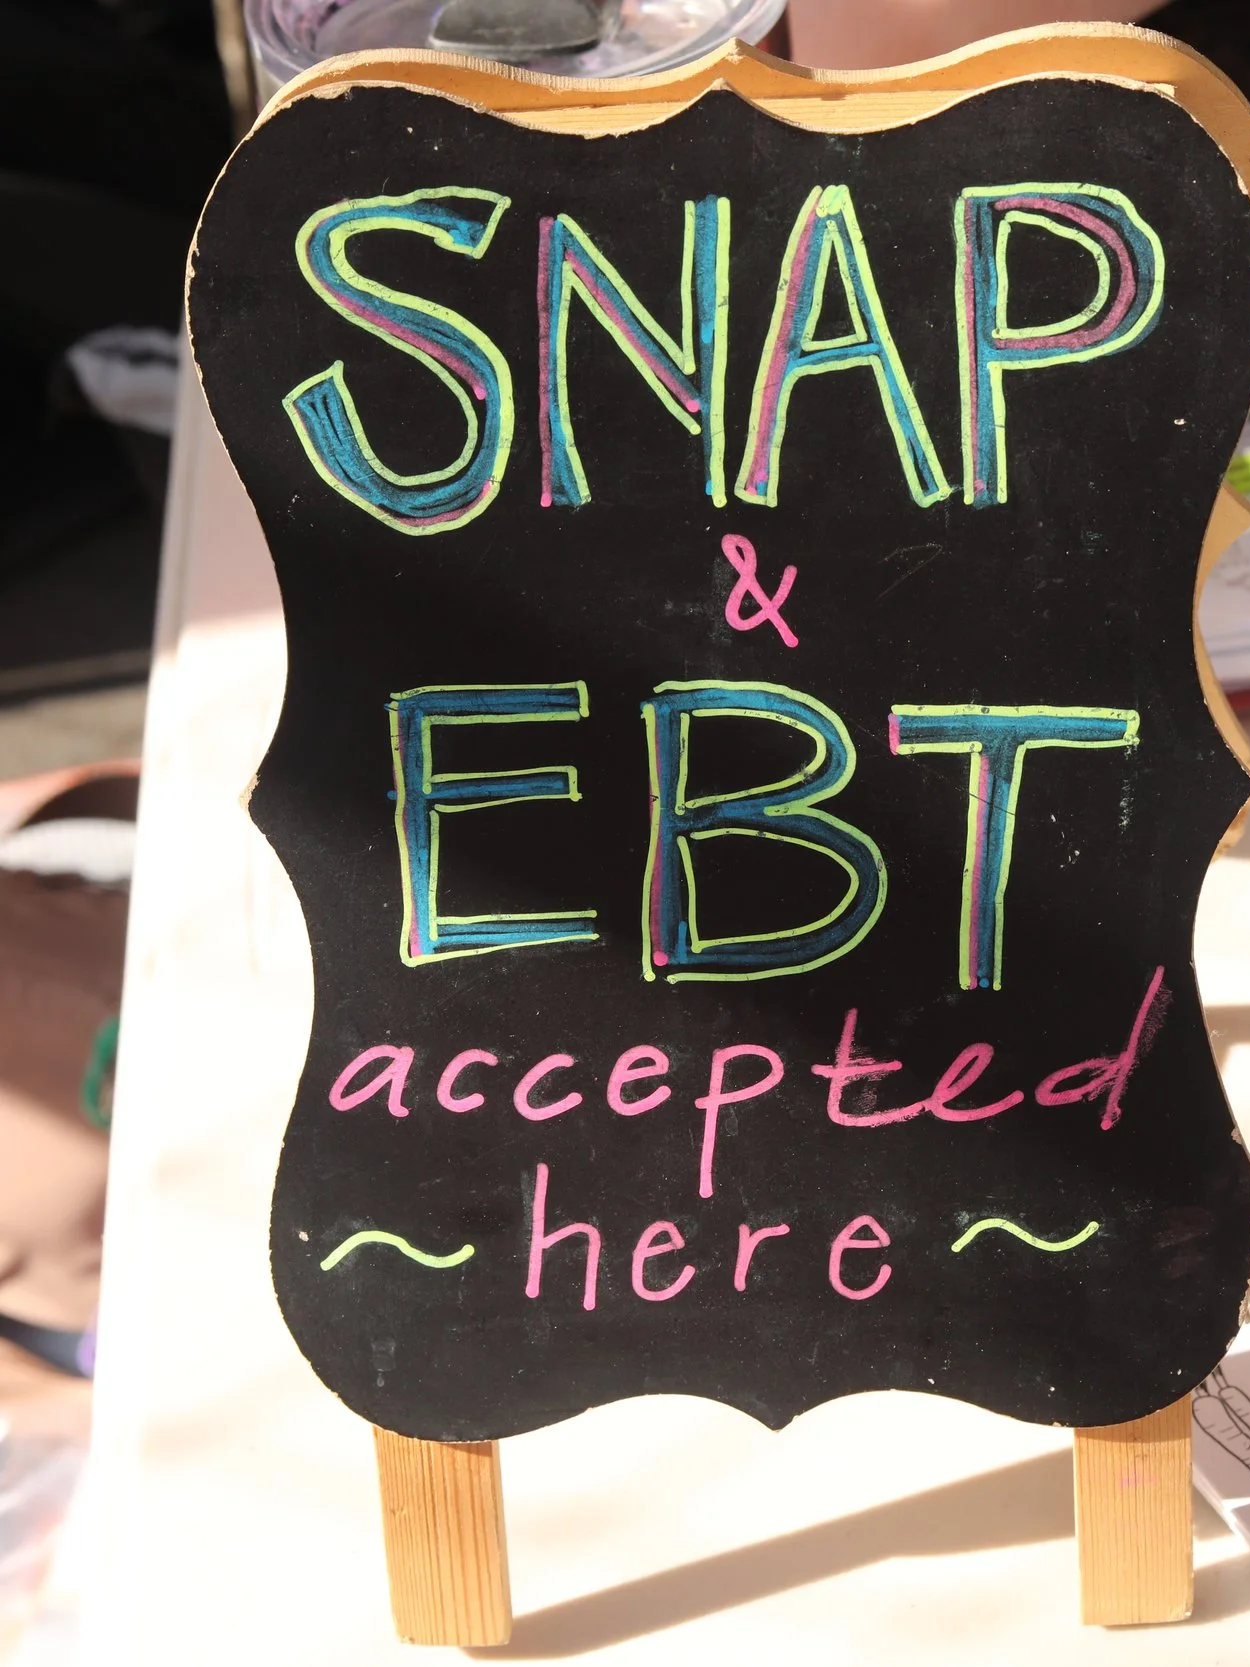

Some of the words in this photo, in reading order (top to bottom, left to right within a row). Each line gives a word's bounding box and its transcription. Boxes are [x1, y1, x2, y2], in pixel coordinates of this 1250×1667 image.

[282, 183, 1166, 537] SNAP
[721, 534, 798, 648] &
[384, 679, 1140, 992] EBT
[327, 965, 1167, 1199] accepted
[525, 1163, 894, 1312] here
